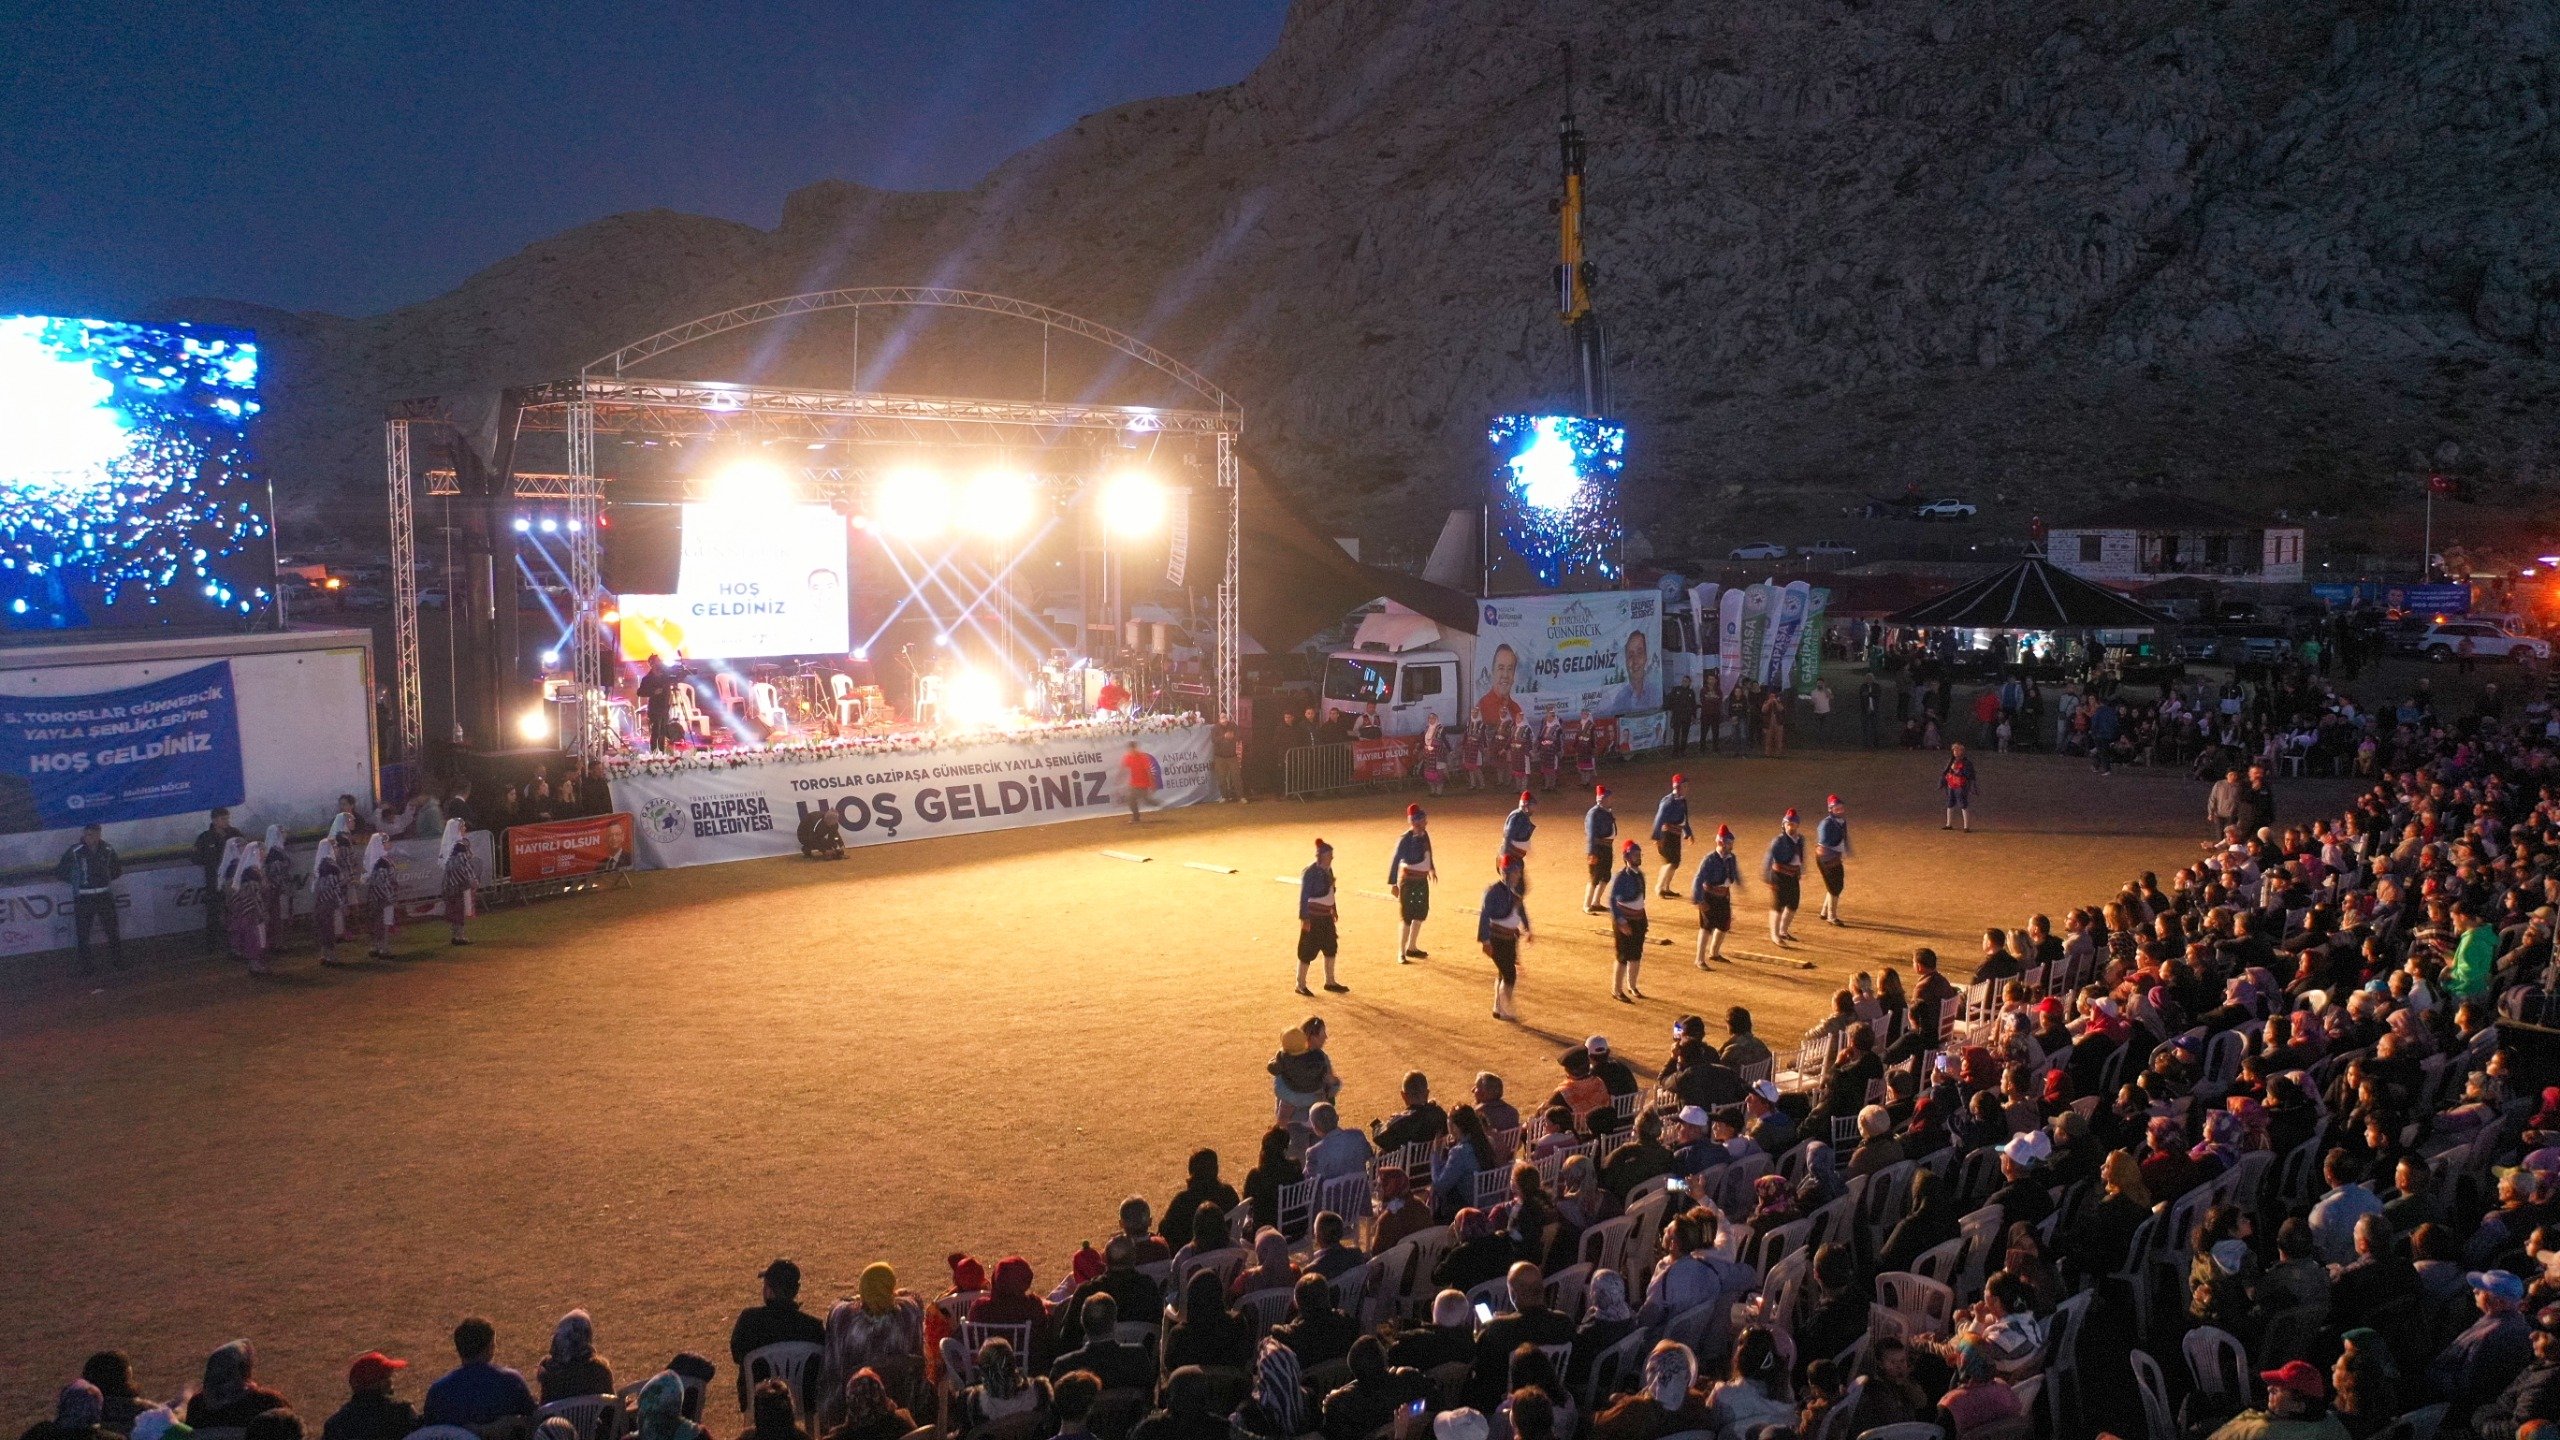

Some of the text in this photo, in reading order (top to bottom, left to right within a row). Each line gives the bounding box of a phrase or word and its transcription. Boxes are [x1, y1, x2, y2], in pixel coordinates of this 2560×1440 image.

[719, 582, 760, 597] HOŞ
[692, 599, 786, 616] GELDİNİZ
[1535, 649, 1617, 678] HOŞ GELDİNİZ
[24, 706, 126, 723] TOROSLAR
[24, 727, 84, 740] YAYLA
[30, 731, 212, 773] HOŞ GELDİNİZ
[1163, 751, 1198, 763] ANTALYA
[790, 751, 1103, 792] TOROSLAR GAZİPAŞA GÜNNERCİK YAYLA ŞENLİĞİNE
[563, 835, 601, 850] OLSUN
